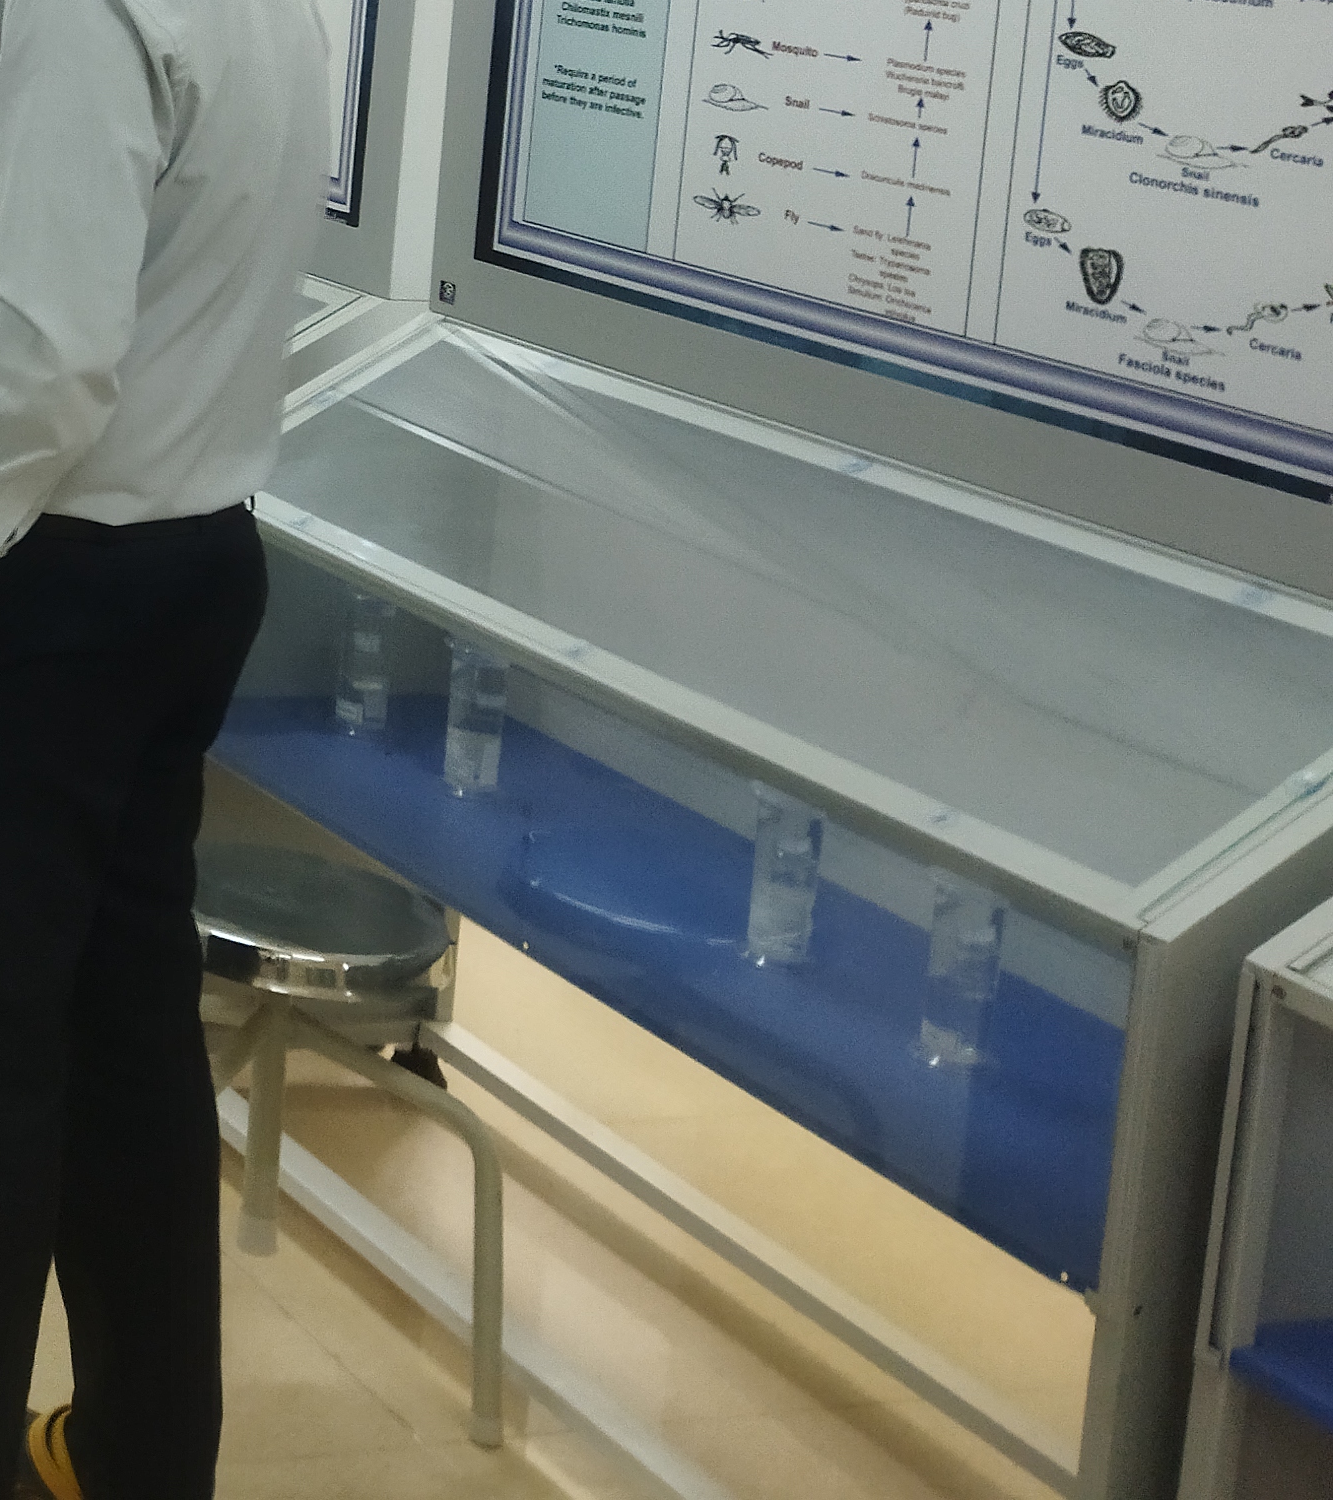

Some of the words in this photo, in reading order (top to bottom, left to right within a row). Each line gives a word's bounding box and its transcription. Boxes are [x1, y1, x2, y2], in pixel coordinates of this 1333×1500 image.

[562, 2, 610, 18] Chilomastix
[557, 15, 609, 31] Trichomonas
[612, 24, 647, 38] hominis
[772, 41, 819, 58] Mosquito
[1056, 55, 1083, 70] Eggs
[591, 73, 596, 81] a
[598, 74, 625, 86] period
[628, 79, 637, 88] of
[542, 90, 567, 103] before
[570, 97, 587, 109] they
[589, 101, 603, 111] are
[543, 78, 587, 93] maturation
[589, 85, 608, 97] after
[610, 92, 646, 106] passage
[785, 96, 810, 109] Snail
[1082, 124, 1144, 145] Miracidium
[758, 152, 804, 171] Copepod
[1271, 149, 1324, 167] Cercaria
[1181, 167, 1210, 182] Snail
[1129, 172, 1199, 196] Clonorchis
[1203, 187, 1260, 208] sinensis
[785, 209, 799, 225] Fly
[1025, 232, 1052, 248] Eggs
[1065, 301, 1127, 324] Miracidium
[1162, 351, 1191, 366] Snail
[1249, 338, 1302, 361] Cercaria
[1118, 353, 1171, 378] Fasciola
[1175, 370, 1225, 392] species
